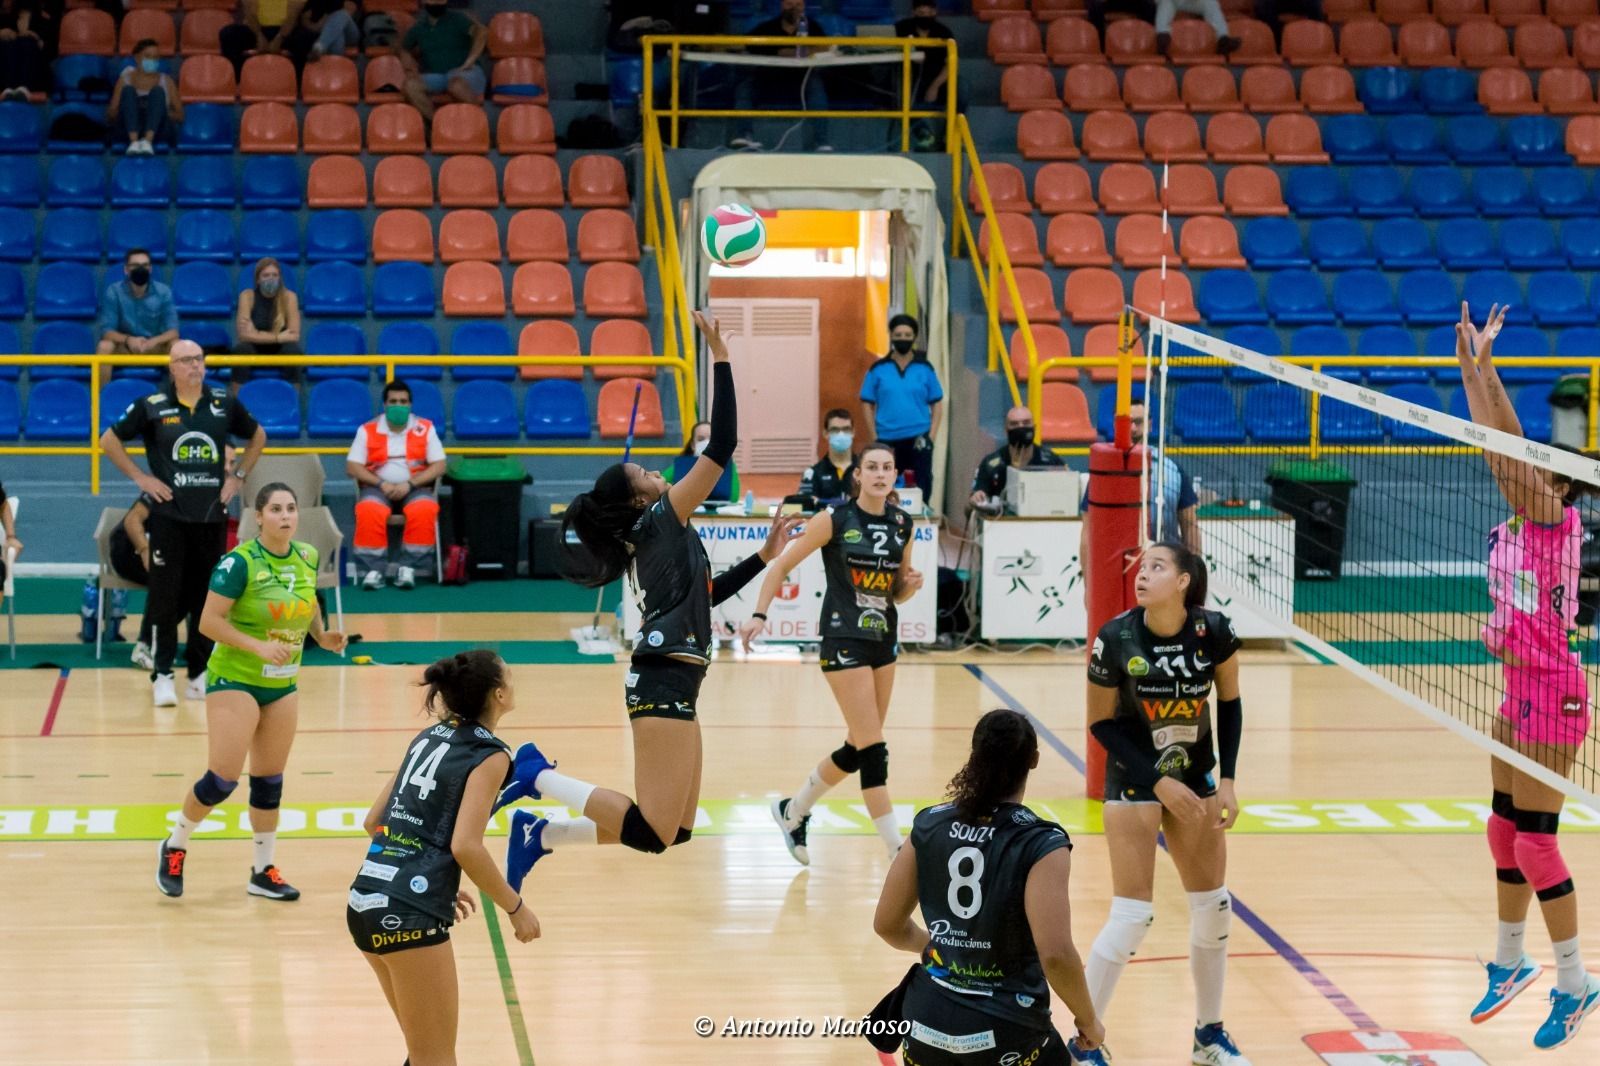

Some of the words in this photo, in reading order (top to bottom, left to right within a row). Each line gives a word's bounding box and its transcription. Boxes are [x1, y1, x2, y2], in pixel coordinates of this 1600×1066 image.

[179, 446, 212, 459] SHC
[1525, 443, 1551, 463] rfevb.com
[872, 531, 889, 555] 2
[281, 573, 296, 593] 7
[851, 568, 893, 590] WAY
[781, 621, 807, 637] DE
[1155, 655, 1192, 678] 11
[1138, 684, 1174, 693] Fundación
[1142, 698, 1206, 721] WAY
[430, 725, 456, 739] SILVA
[399, 738, 450, 801] 14
[947, 846, 985, 919] 8
[371, 930, 422, 948] Divisa
[948, 960, 1004, 977] Andalucía
